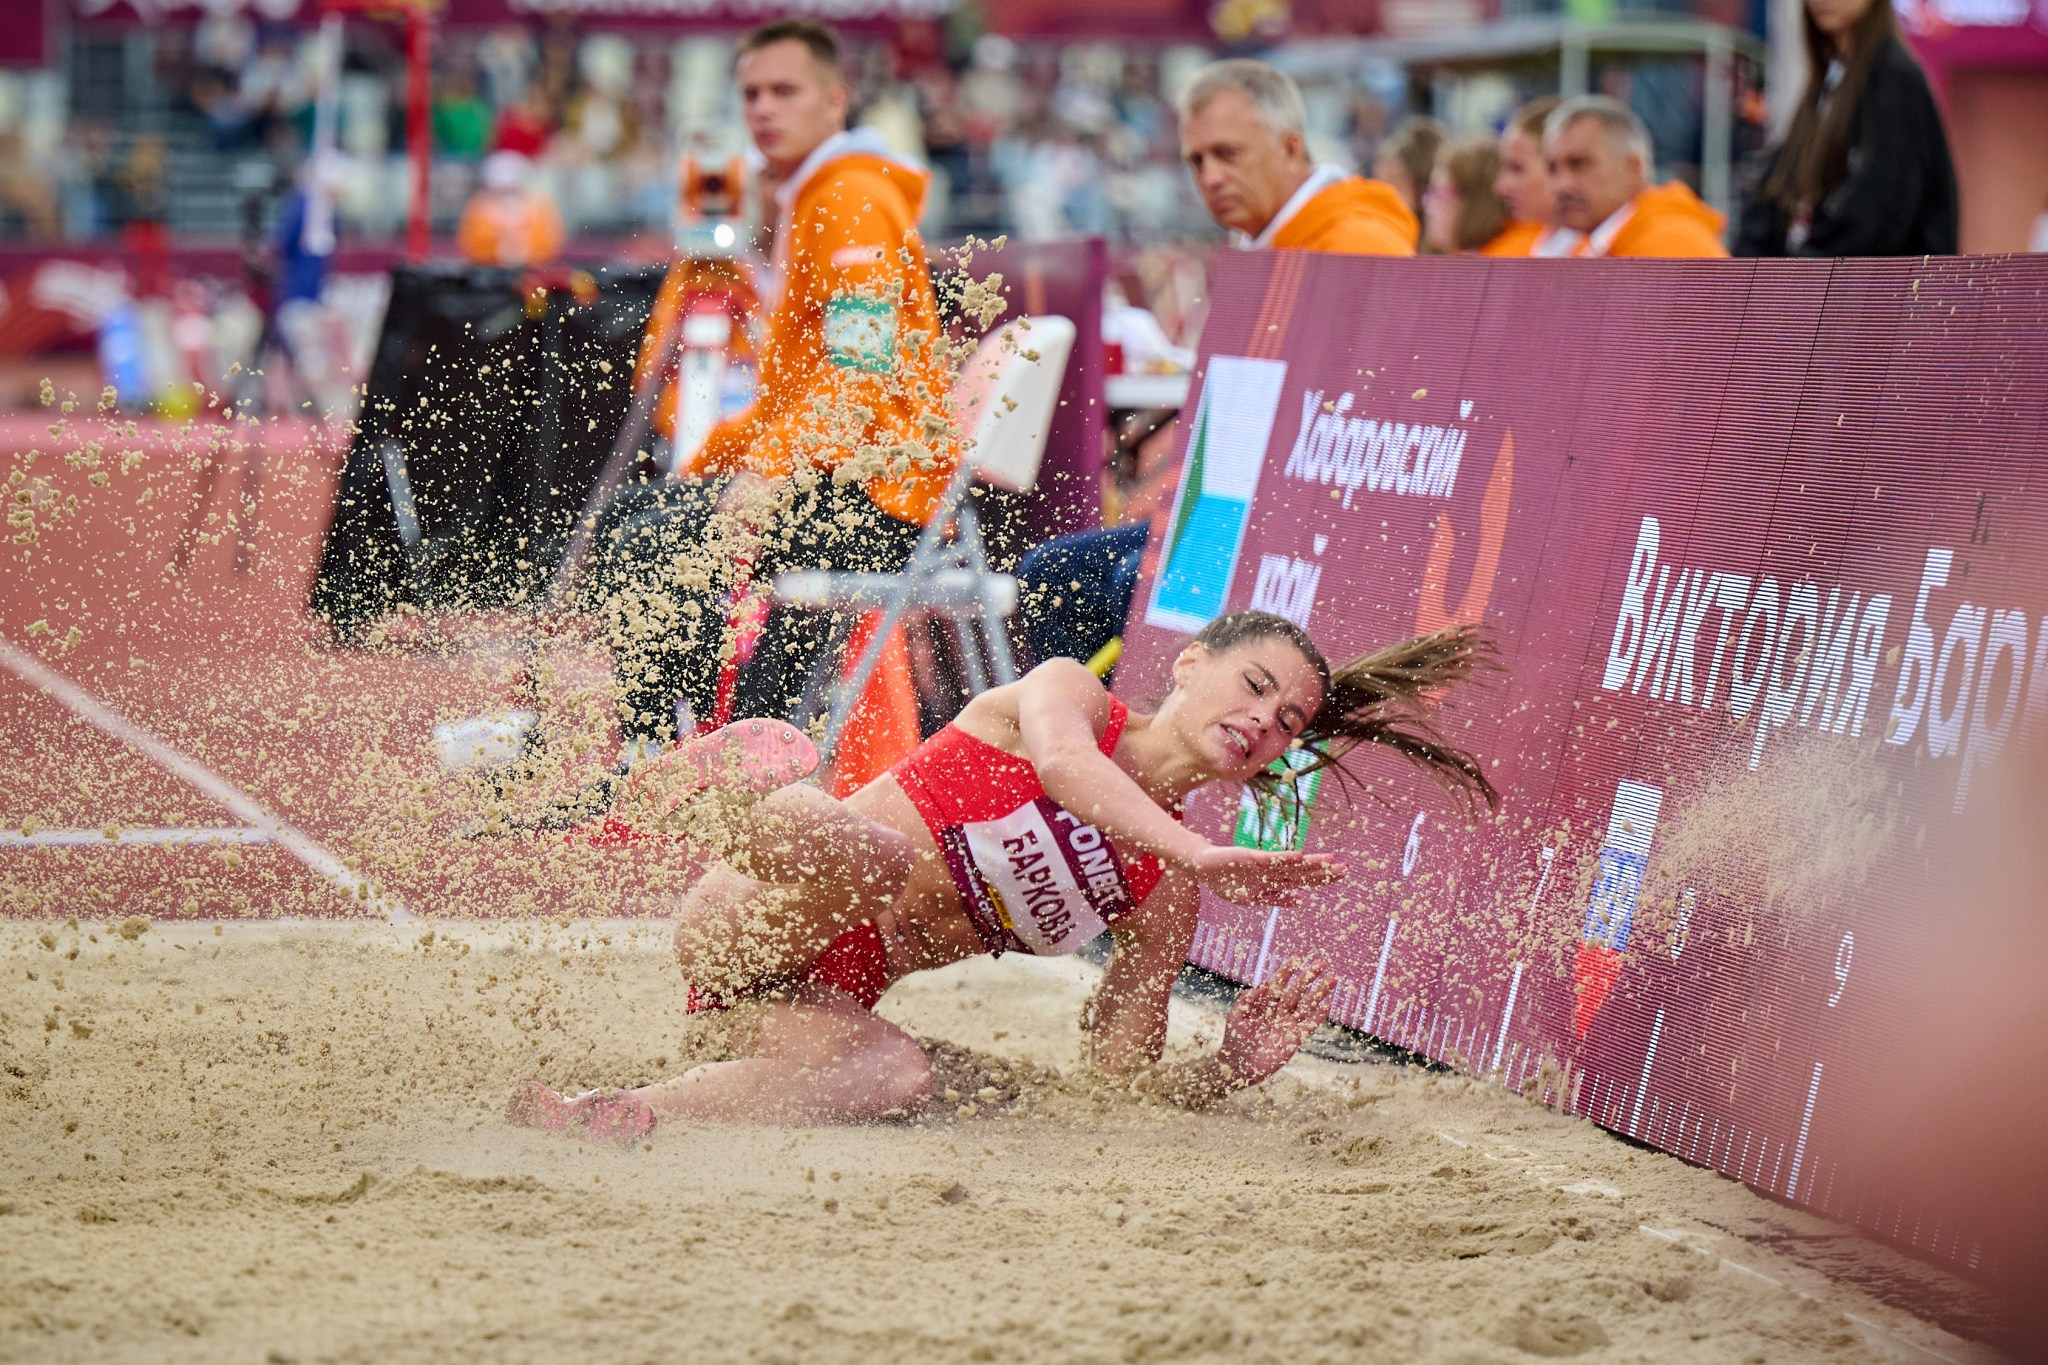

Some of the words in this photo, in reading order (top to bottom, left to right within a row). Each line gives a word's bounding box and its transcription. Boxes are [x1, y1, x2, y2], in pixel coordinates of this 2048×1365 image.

[1284, 389, 1474, 510] Хабаровский
[1601, 516, 1893, 771] Виктория
[1003, 829, 1076, 946] БАРКОВА
[1403, 811, 1425, 877] 6
[1827, 931, 1854, 1007] 9
